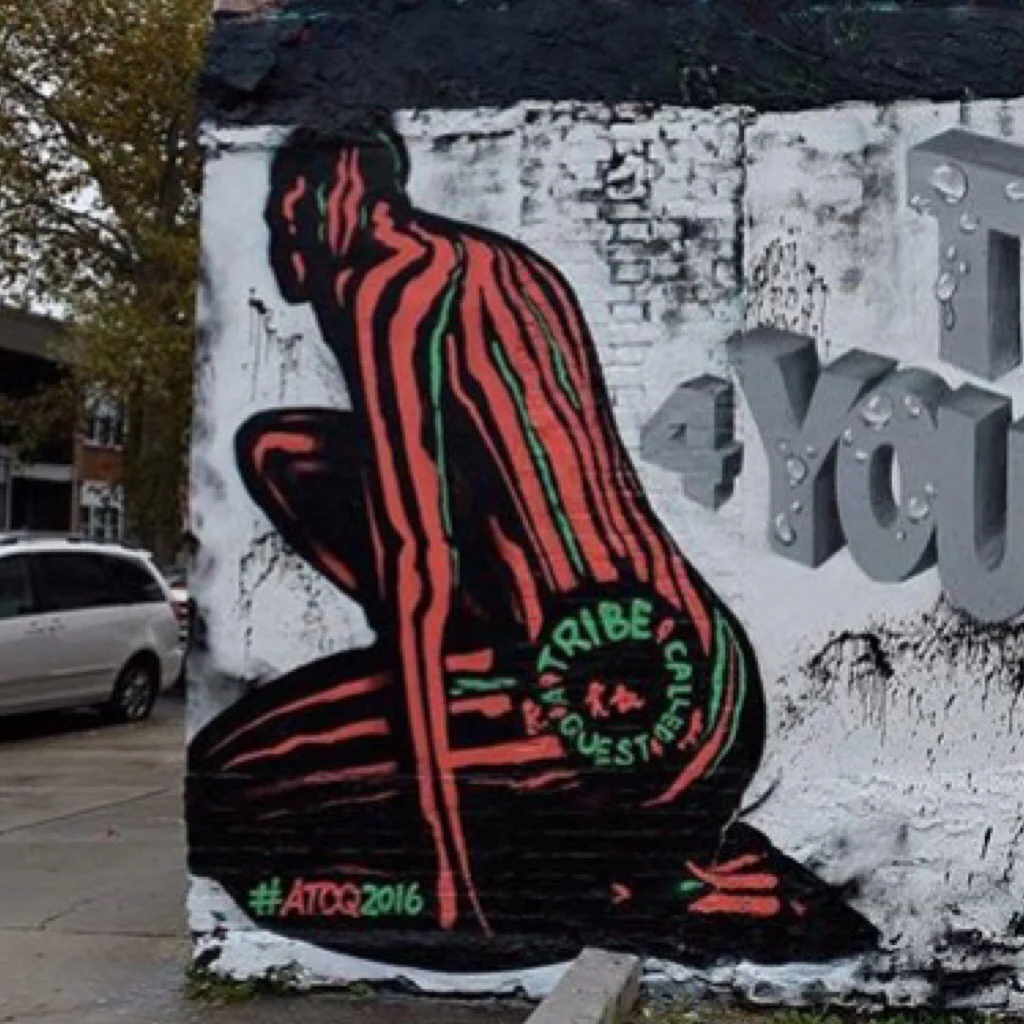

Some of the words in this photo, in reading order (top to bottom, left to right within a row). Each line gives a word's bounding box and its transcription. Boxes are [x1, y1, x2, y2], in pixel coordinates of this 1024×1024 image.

[641, 372, 744, 510] 4
[537, 598, 653, 673] TRIBE
[654, 641, 693, 742] CALLED
[560, 713, 650, 766] QUEST
